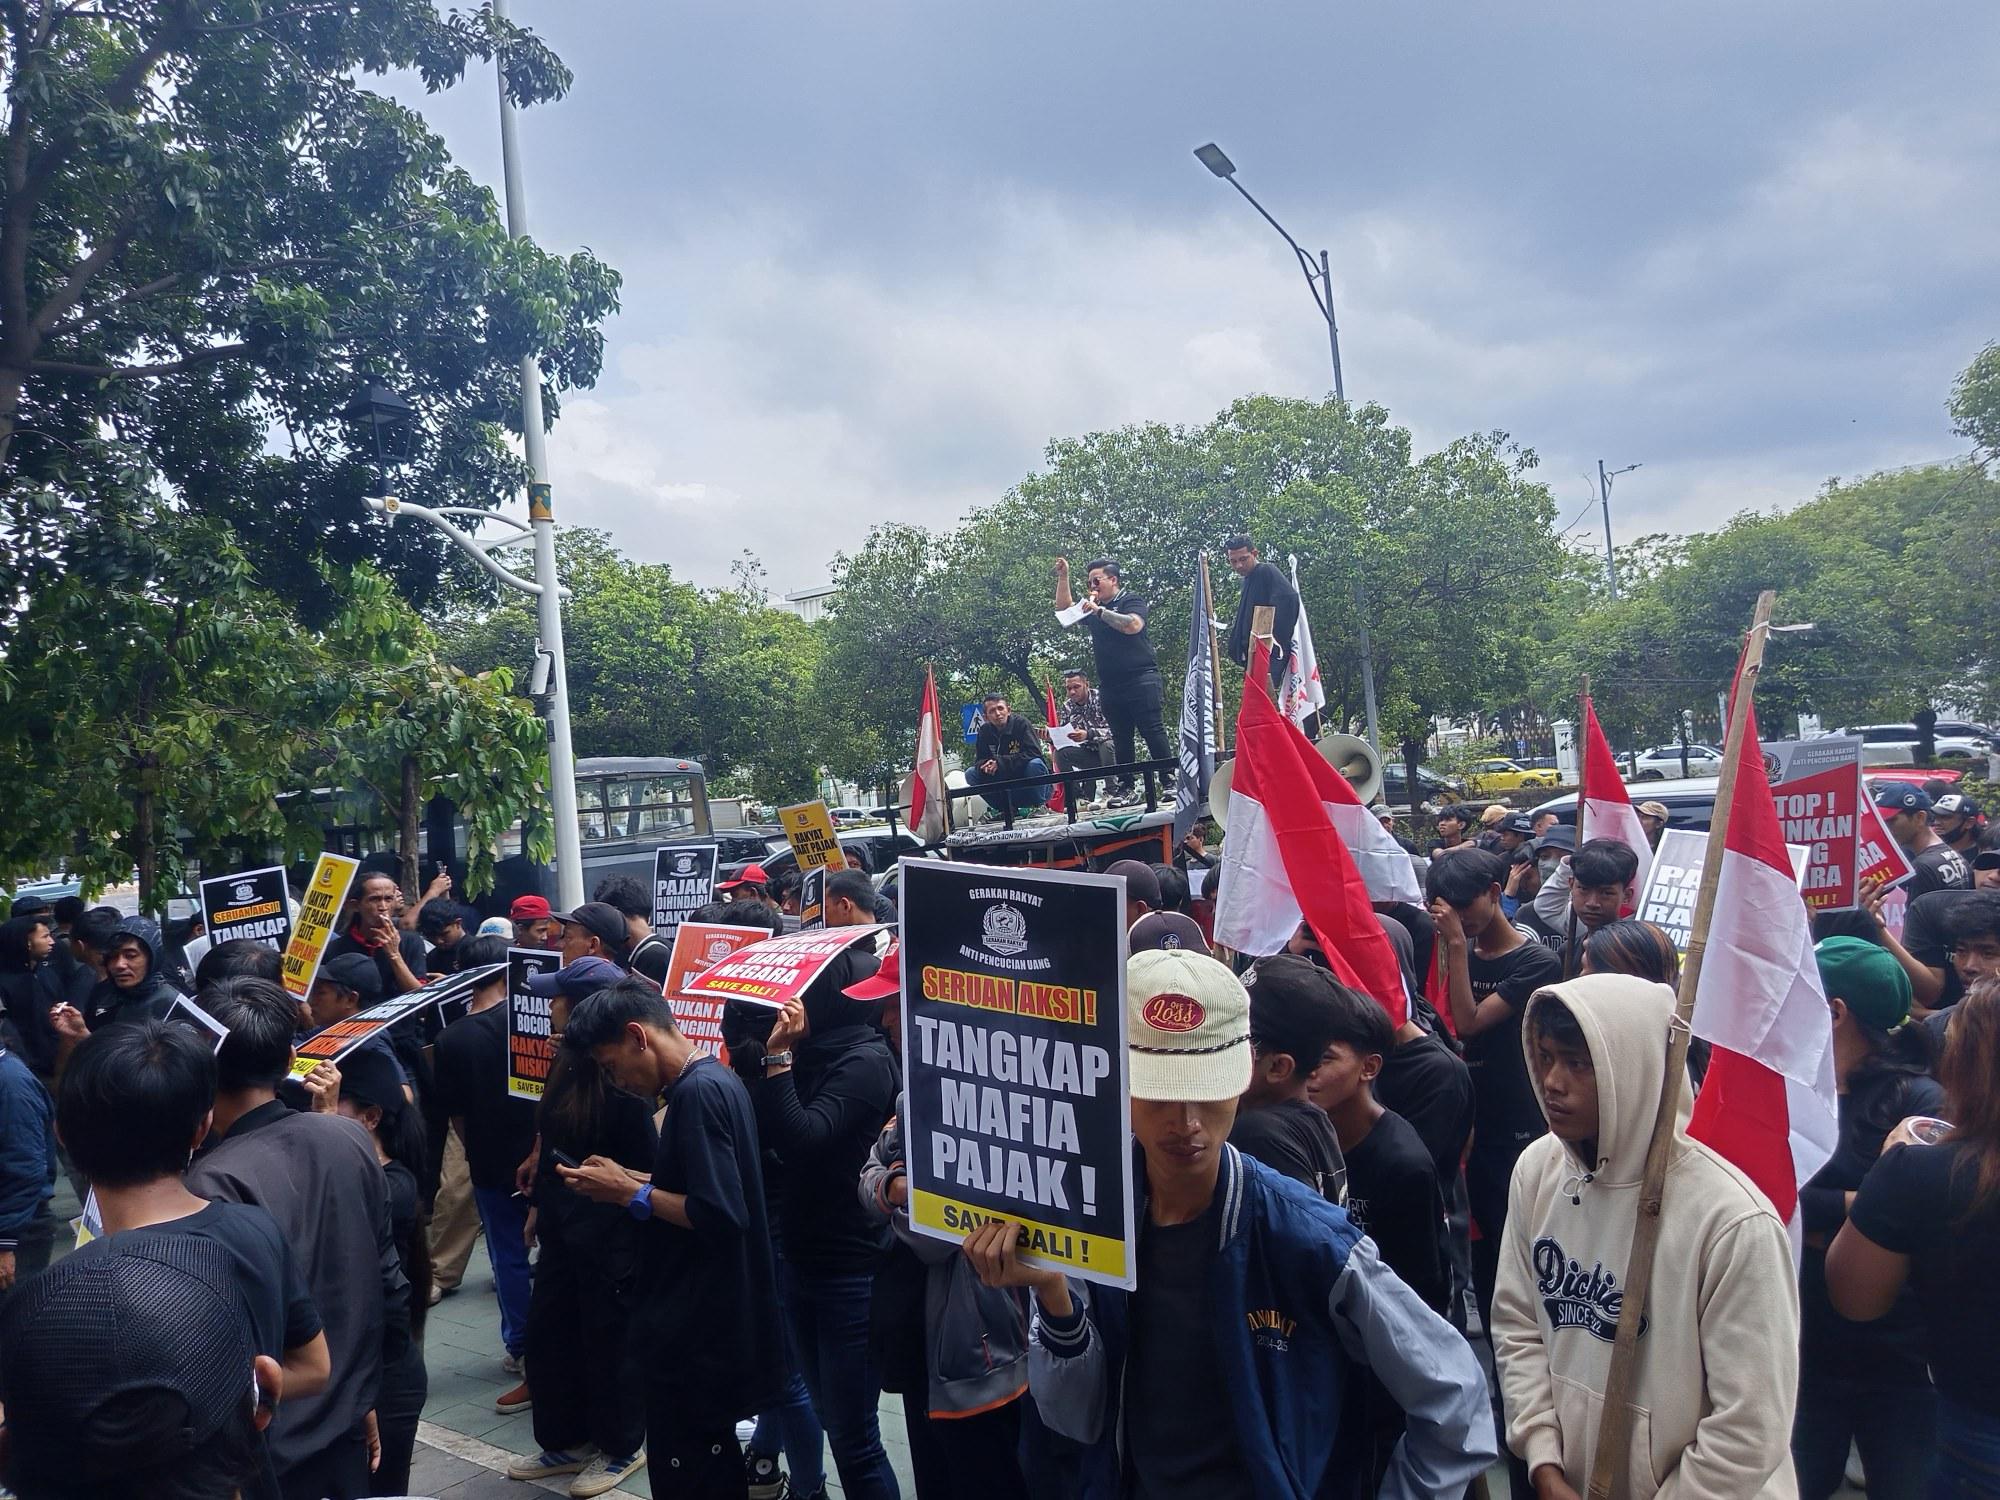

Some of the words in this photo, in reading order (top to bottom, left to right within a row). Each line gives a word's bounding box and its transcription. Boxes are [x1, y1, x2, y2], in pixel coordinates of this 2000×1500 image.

[1774, 793, 1822, 819] TOP
[794, 828, 824, 844] RAKYAT
[810, 837, 838, 854] PAJAK
[657, 878, 710, 896] PAJAK
[968, 887, 1009, 901] GERAKAN
[1009, 889, 1044, 908] RAKYAT
[1806, 894, 1828, 907] ALI
[214, 906, 252, 925] SERUAN
[212, 917, 288, 945] TANGKAP
[744, 952, 806, 968] UANG
[959, 944, 980, 961] ANTI
[979, 951, 1027, 971] PENCUCIAN
[1026, 957, 1051, 970] UANG
[715, 963, 801, 986] NEGARA
[706, 979, 740, 991] SAVE
[740, 983, 771, 997] BALI
[922, 965, 1016, 1014] SERUAN
[1015, 980, 1082, 1025] AKSI
[1083, 989, 1098, 1026] !
[513, 994, 552, 1016] PAJAK
[516, 1014, 552, 1036] BOCOR
[516, 1055, 551, 1078] MISKI
[914, 1015, 1111, 1097] TANGKAP
[516, 1081, 534, 1093] SAVE
[940, 1077, 1081, 1155] MAFIA
[931, 1130, 1071, 1211] PAJAK
[1080, 1165, 1097, 1217] !
[943, 1204, 1005, 1233] SAV
[1017, 1225, 1073, 1259] BALI
[1080, 1239, 1090, 1263] !
[1533, 1236, 1624, 1319] Dickie
[1557, 1303, 1590, 1325] SINCE
